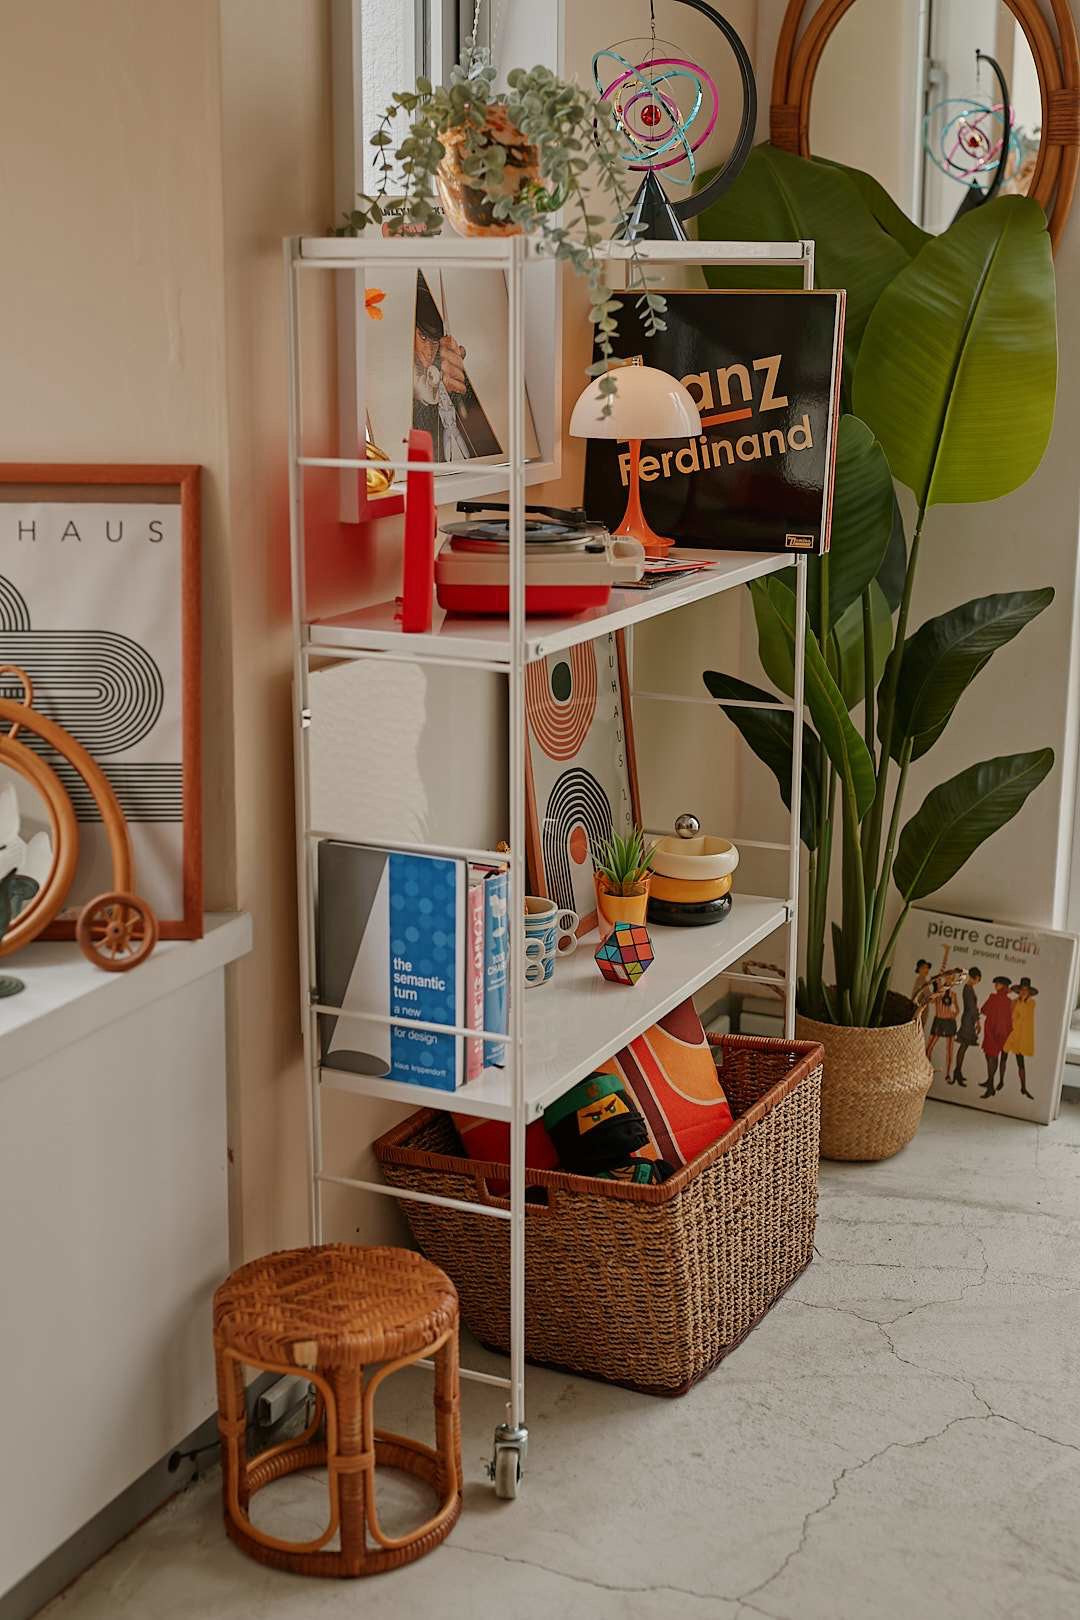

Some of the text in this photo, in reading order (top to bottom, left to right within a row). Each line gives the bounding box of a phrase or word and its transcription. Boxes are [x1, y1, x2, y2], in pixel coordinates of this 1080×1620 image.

[617, 414, 814, 486] Ferdinand
[927, 920, 980, 943] pierre
[393, 957, 412, 972] the
[393, 972, 446, 992] semantic
[393, 985, 418, 1001] turn
[393, 1005, 421, 1017] a new
[394, 1025, 438, 1046] for design
